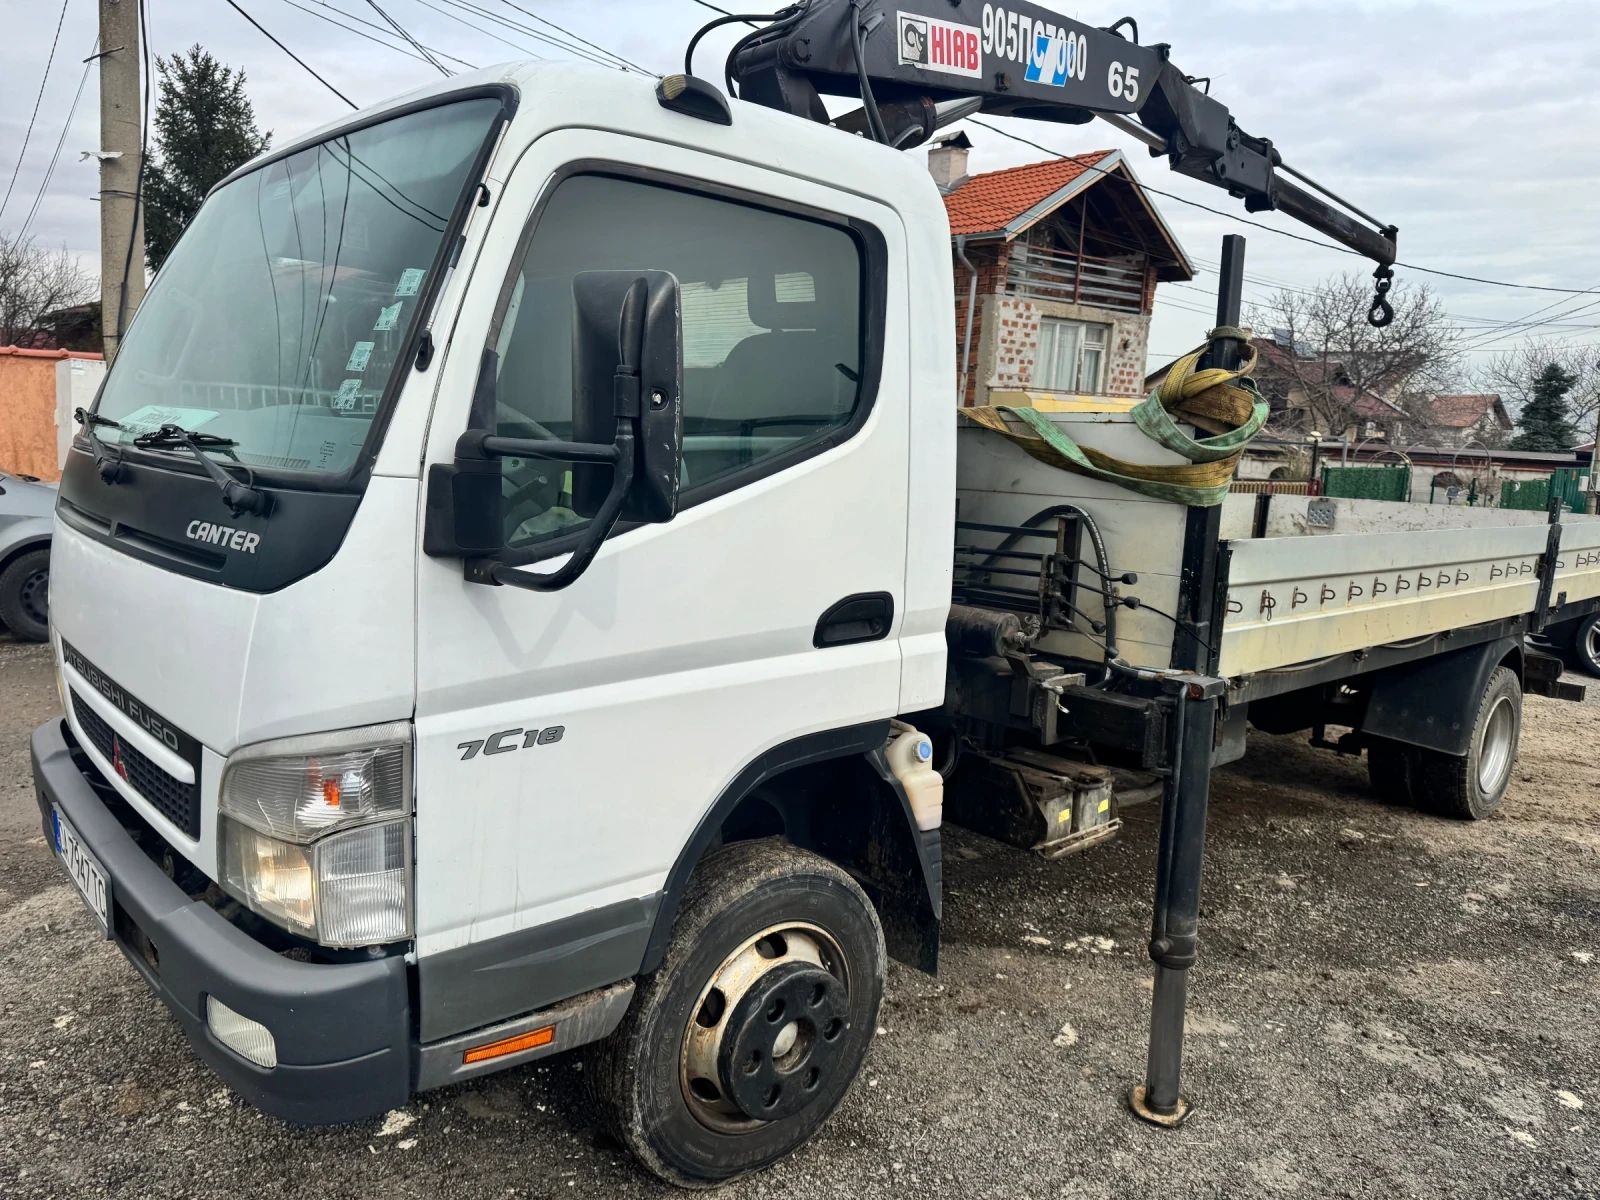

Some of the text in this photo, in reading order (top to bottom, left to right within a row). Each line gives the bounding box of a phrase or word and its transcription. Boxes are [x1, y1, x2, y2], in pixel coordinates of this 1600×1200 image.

[931, 25, 979, 71] HIAB
[1107, 60, 1140, 103] 65
[186, 519, 260, 554] CANTER
[64, 645, 179, 751] MITSUBISHI FUSO
[457, 725, 566, 761] 7C18
[68, 836, 90, 894] 7947
[91, 867, 106, 918] TC
